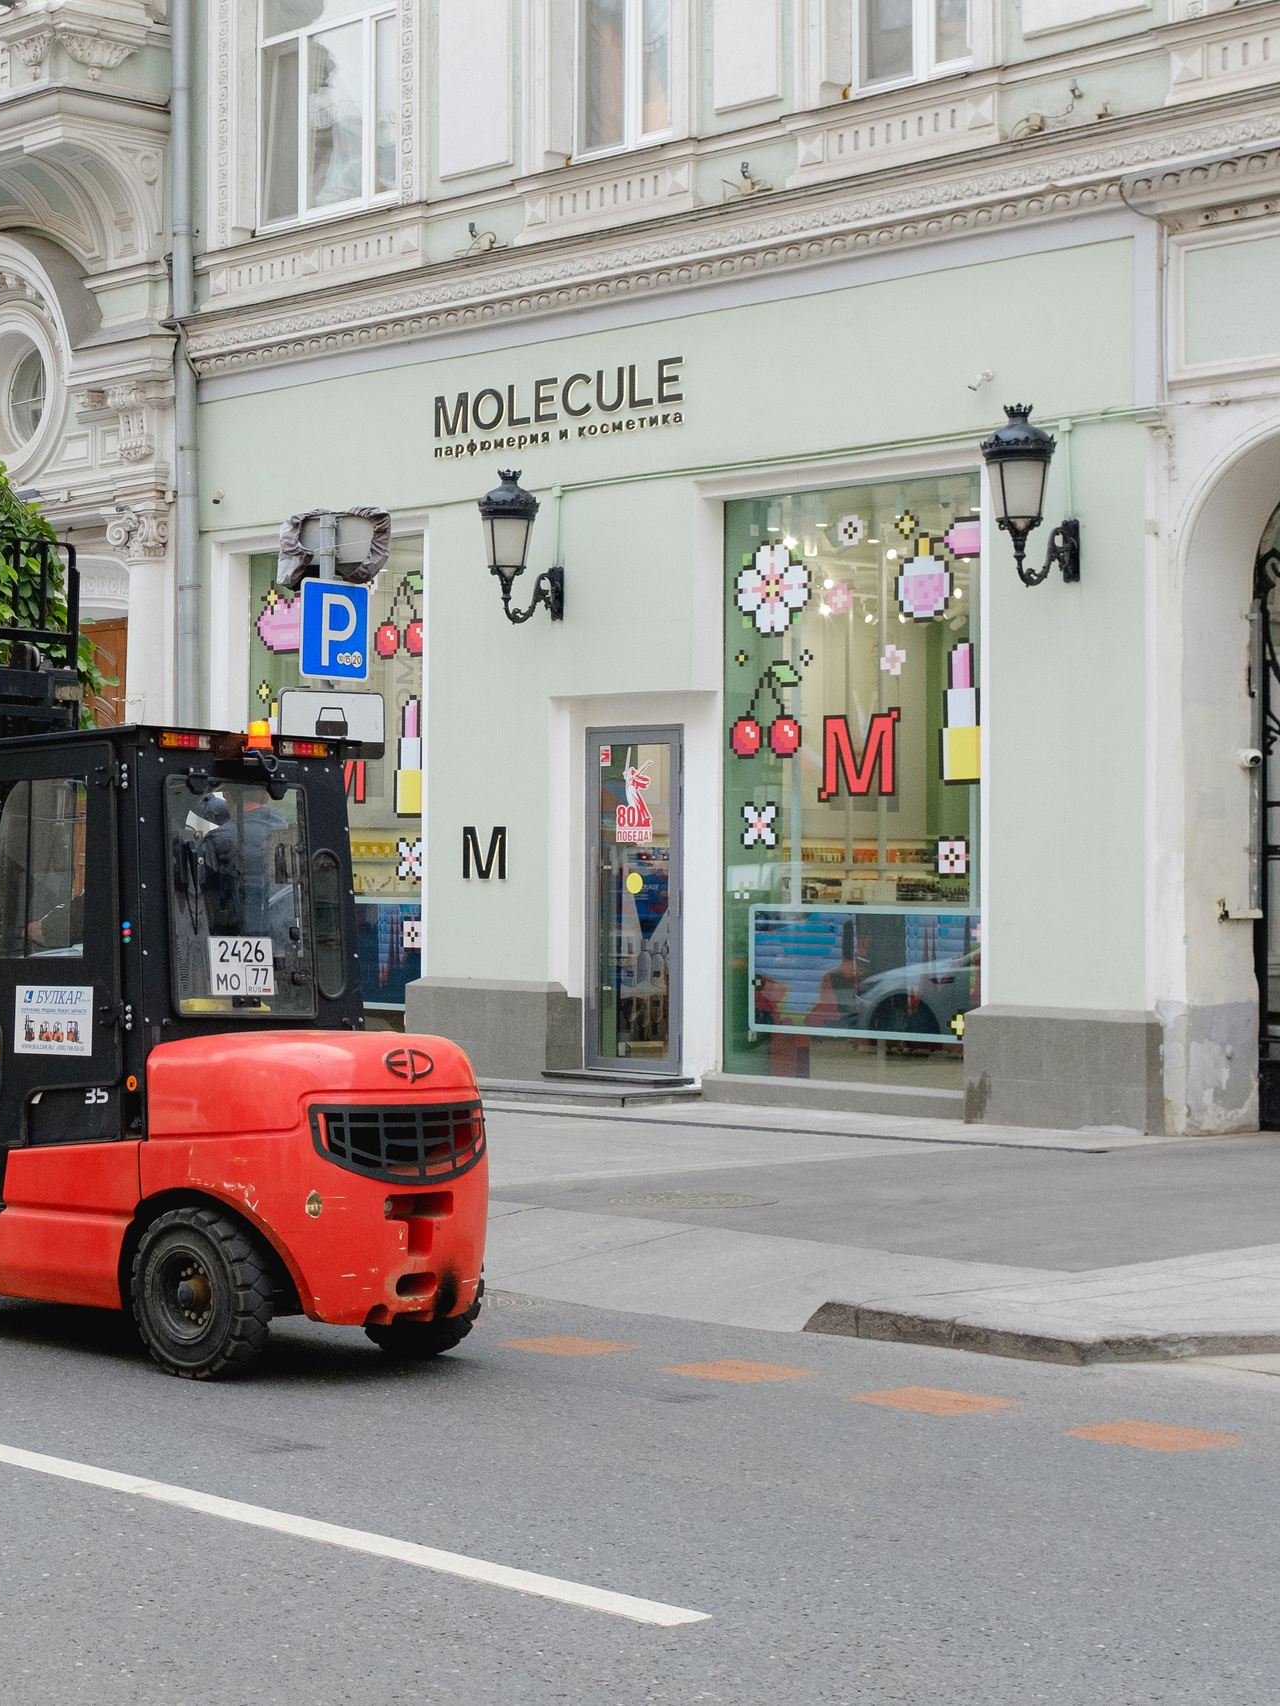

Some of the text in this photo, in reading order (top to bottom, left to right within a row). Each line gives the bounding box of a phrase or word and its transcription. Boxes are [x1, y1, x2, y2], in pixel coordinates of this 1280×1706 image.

[434, 356, 684, 438] MOLECULE
[434, 411, 684, 458] парфюмерия и косметика
[320, 592, 357, 667] P
[352, 655, 362, 665] 20
[818, 706, 901, 803] M
[617, 805, 636, 827] 80
[616, 830, 652, 842] ПОБЕДА!
[462, 826, 507, 880] M
[218, 940, 265, 963] 2426
[251, 968, 269, 985] 77
[35, 990, 83, 1005] БУЛКАР
[84, 1087, 109, 1104] 35
